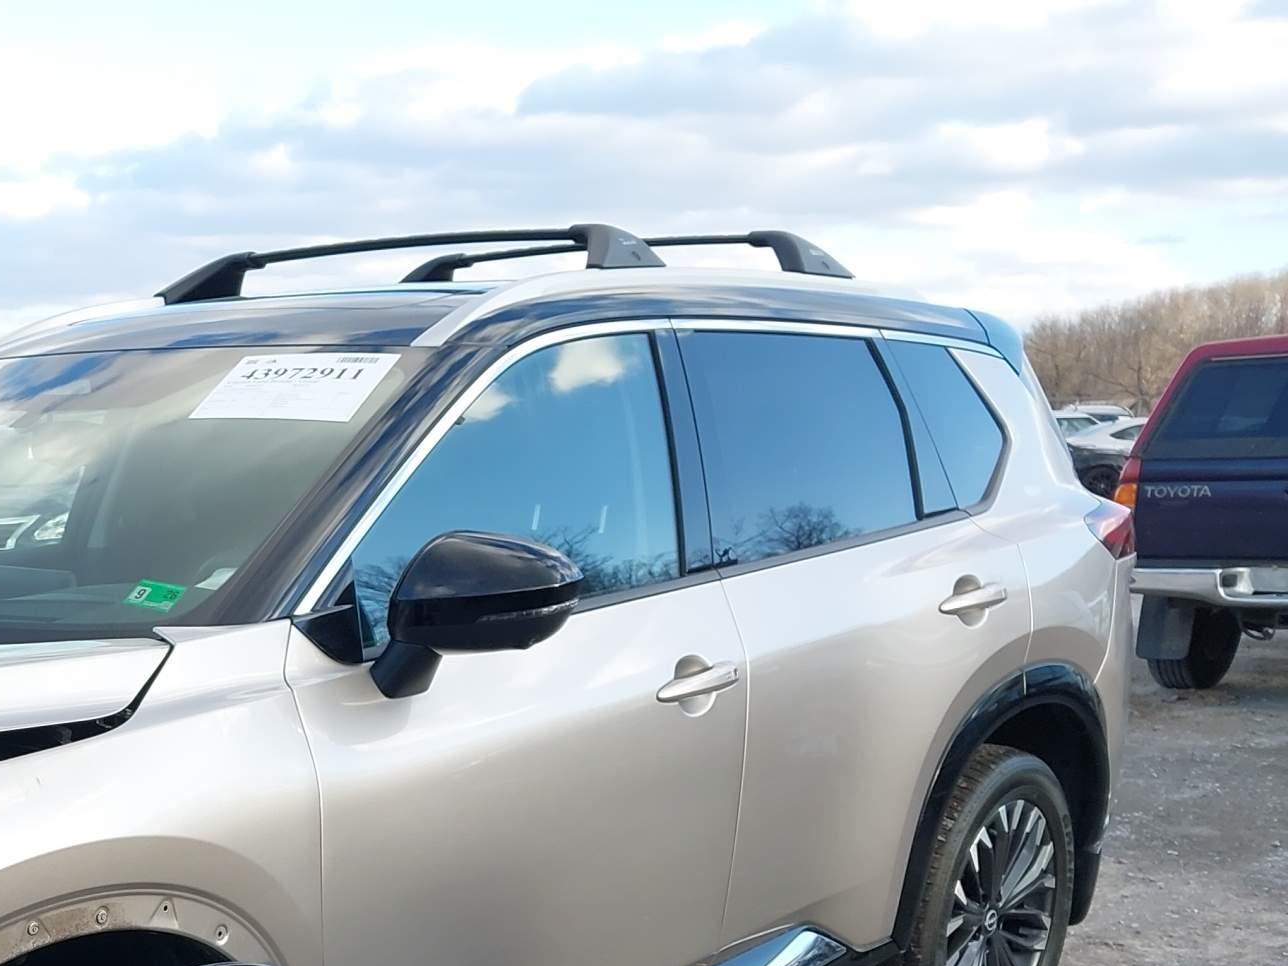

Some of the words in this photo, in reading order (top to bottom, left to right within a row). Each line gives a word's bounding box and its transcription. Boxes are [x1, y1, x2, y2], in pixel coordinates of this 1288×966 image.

[240, 366, 365, 380] 43972911
[1143, 484, 1213, 499] TOYOTA
[134, 588, 148, 600] 9
